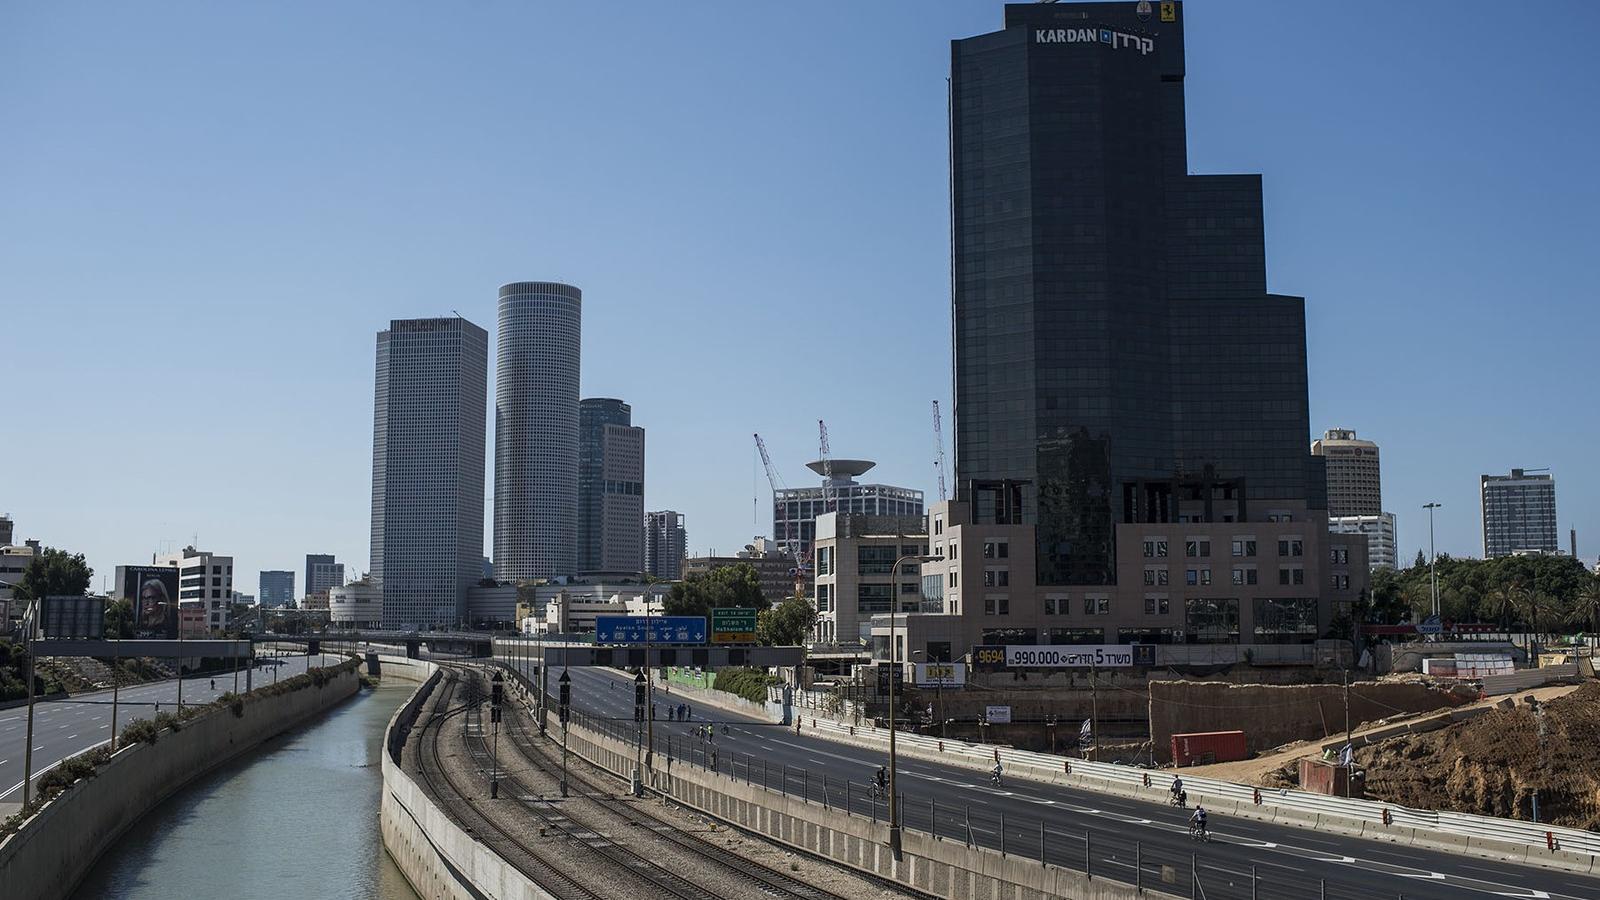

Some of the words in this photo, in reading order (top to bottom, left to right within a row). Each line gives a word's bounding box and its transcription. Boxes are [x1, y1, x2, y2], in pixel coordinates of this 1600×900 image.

[1036, 29, 1097, 43] KARDAN
[1112, 31, 1154, 55] קרדן
[978, 650, 1005, 663] 9694
[1096, 649, 1104, 664] 5
[1105, 653, 1131, 664] משרד
